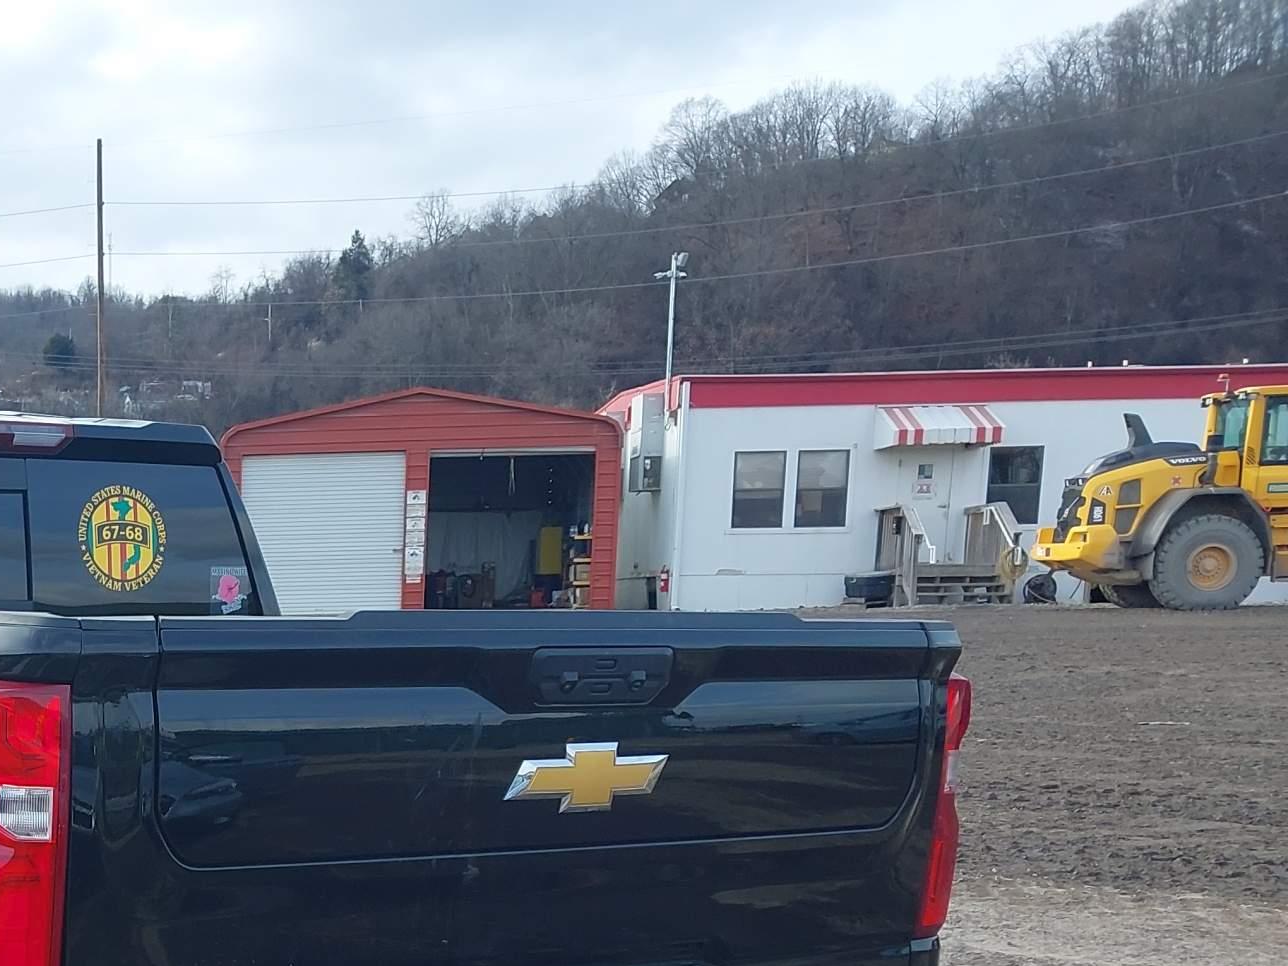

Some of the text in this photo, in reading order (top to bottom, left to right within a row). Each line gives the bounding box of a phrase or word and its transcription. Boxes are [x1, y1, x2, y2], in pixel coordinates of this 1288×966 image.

[1169, 456, 1207, 465] VOLVO
[78, 485, 167, 544] UNITED STATES MARINE CORPS
[102, 525, 143, 541] 67-68
[82, 552, 165, 592] VIETNAM VETERAN
